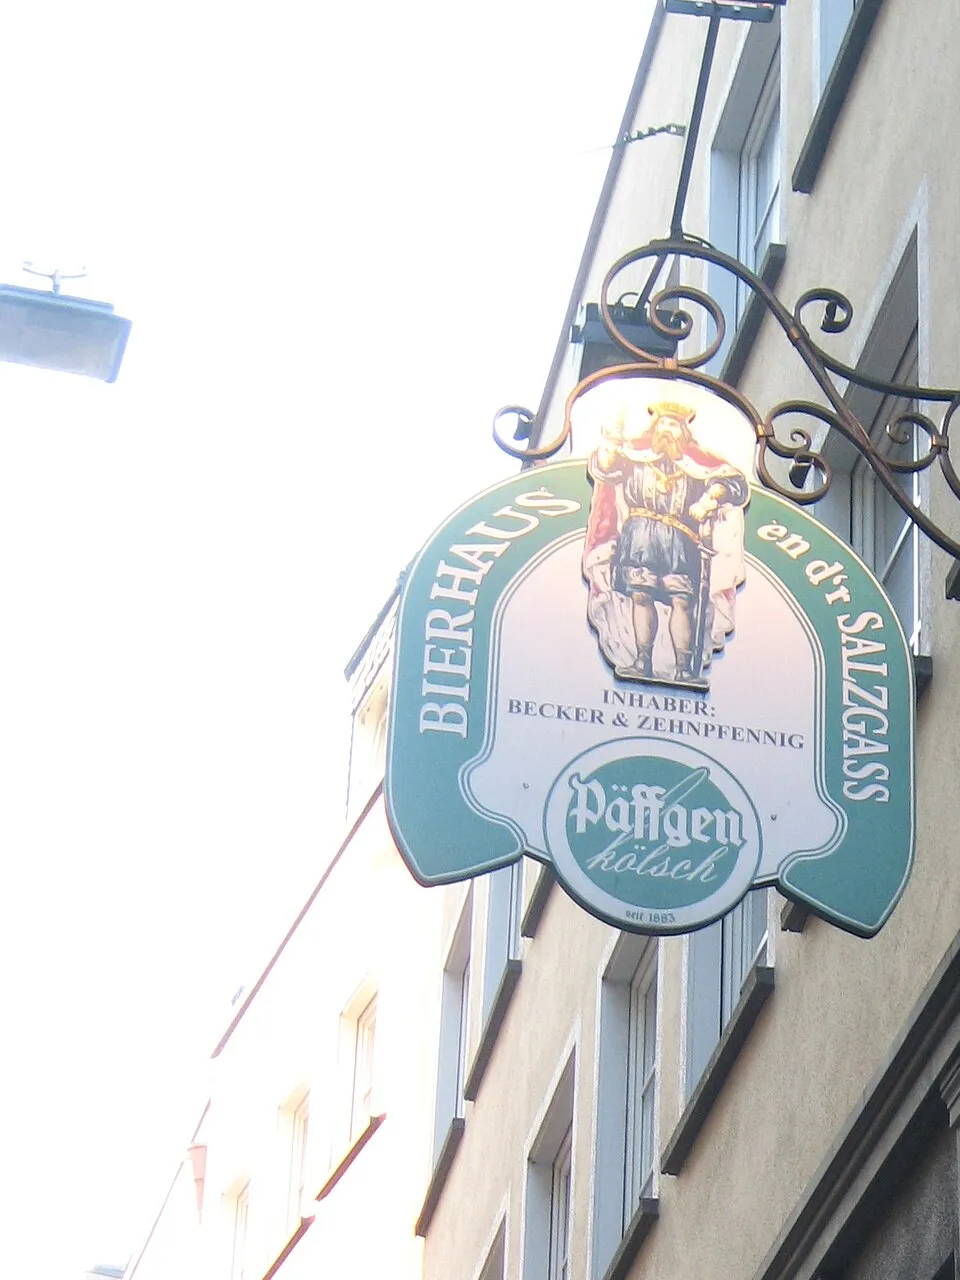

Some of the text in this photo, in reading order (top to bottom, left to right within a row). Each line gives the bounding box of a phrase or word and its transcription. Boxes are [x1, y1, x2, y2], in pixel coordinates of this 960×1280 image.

[420, 486, 582, 739] BIERHAUS
[508, 698, 805, 751] BECKER & ZEHNPFENNIG
[602, 688, 716, 718] INHABER:
[836, 610, 891, 803] SALZGASS
[568, 774, 747, 848] Päffgen
[585, 808, 729, 884] kölsch
